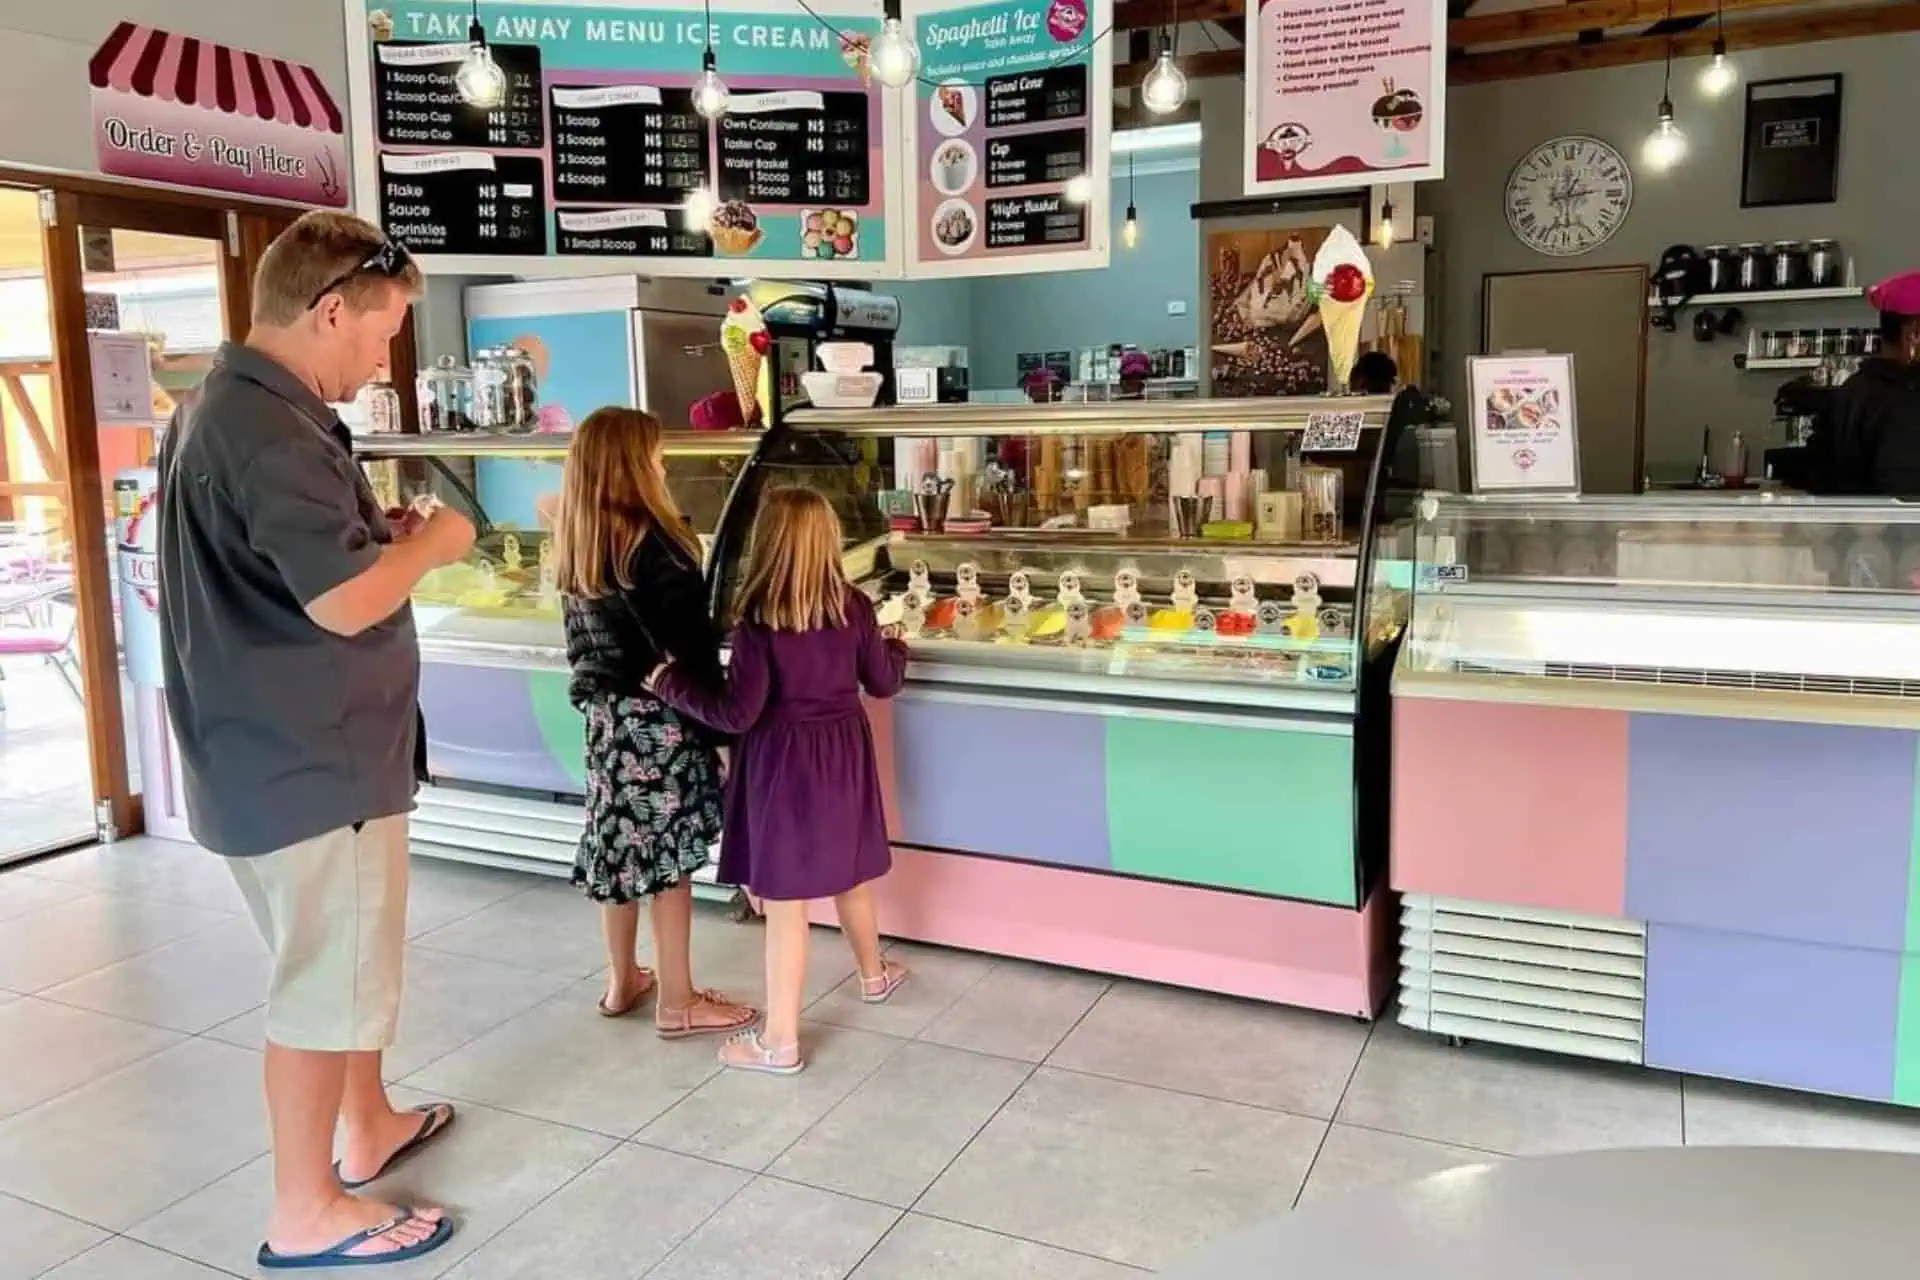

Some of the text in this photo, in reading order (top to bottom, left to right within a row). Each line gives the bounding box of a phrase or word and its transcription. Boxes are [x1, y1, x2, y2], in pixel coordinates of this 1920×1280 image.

[495, 16, 572, 40] AWAY
[586, 20, 664, 43] MENU
[677, 22, 720, 45] ICE
[733, 25, 829, 49] CREAM
[925, 12, 1009, 50] Spaghetti
[1014, 8, 1040, 30] Ice
[394, 71, 426, 86] Scoop
[1019, 77, 1044, 91] Cone
[385, 90, 393, 101] 2
[394, 91, 426, 104] Scoop
[395, 110, 428, 123] Scoop
[430, 111, 452, 123] Cup
[488, 111, 507, 126] N$
[566, 114, 600, 128] Scoop
[645, 114, 663, 128] N$
[723, 118, 748, 129] Own
[748, 119, 800, 131] Container
[807, 119, 825, 133] N$
[396, 128, 429, 141] Scoop
[430, 128, 452, 140] Cup
[488, 128, 507, 143] N$
[557, 134, 564, 145] 2
[566, 133, 606, 147] Scoops
[645, 133, 663, 147] N$
[104, 118, 305, 178] Order & Pay Here
[754, 139, 777, 152] Cup
[807, 138, 824, 152] N$
[990, 142, 1011, 159] Cup
[558, 154, 565, 165] 3
[567, 153, 606, 166] Scoops
[645, 153, 663, 167] N$
[724, 157, 789, 169] Wafer Basket
[557, 173, 565, 184] 4
[567, 173, 606, 187] Scoops
[645, 172, 663, 187] N$
[757, 170, 790, 183] Scoop
[807, 170, 824, 183] N$
[386, 183, 497, 199] Flake N$
[757, 184, 791, 197] Scoop
[808, 183, 825, 197] N$
[388, 202, 431, 217] Sauce
[478, 203, 497, 218] N$
[990, 201, 1022, 219] Wafer
[388, 222, 447, 238] Sprinkles
[479, 223, 498, 237] N$
[571, 237, 601, 249] Small
[602, 238, 637, 251] Scoop
[650, 237, 668, 251] N$
